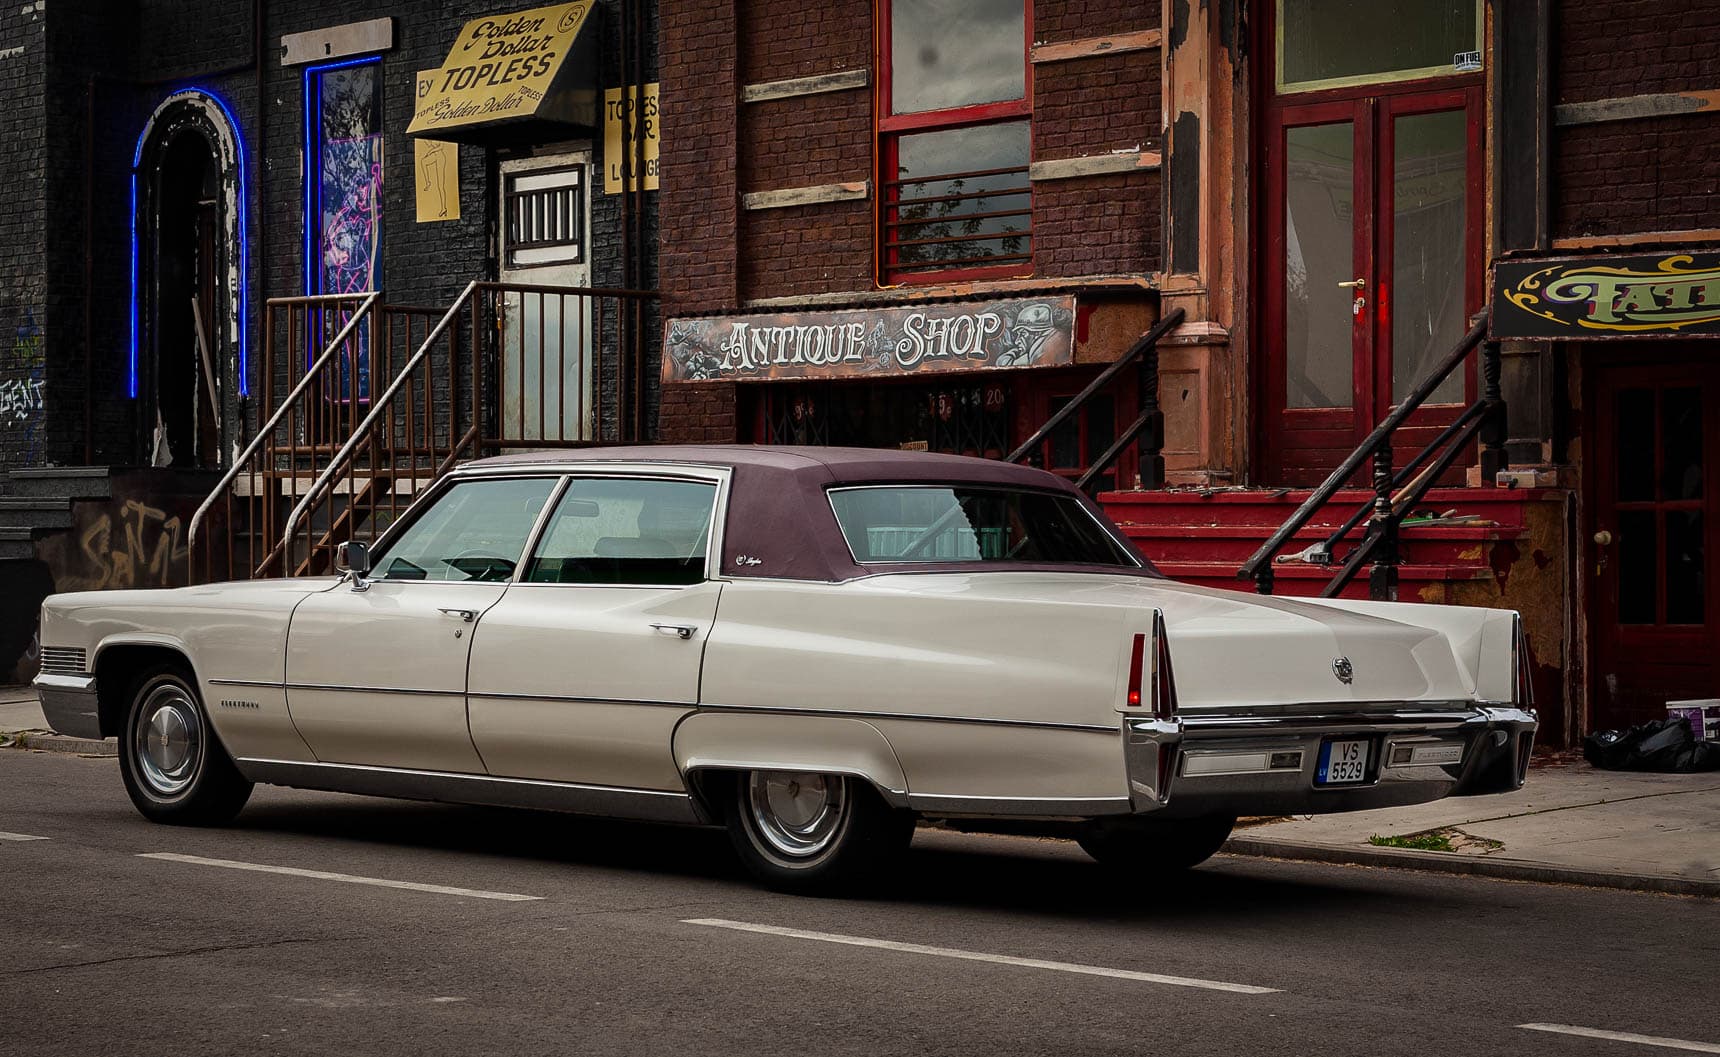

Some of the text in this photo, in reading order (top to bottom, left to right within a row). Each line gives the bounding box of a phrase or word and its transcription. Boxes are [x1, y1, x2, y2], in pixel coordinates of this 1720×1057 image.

[464, 16, 545, 51] Golden
[479, 34, 554, 60] Dollar
[440, 52, 556, 93] TOPLESS
[520, 85, 545, 101] TOPLESS
[416, 97, 450, 119] TOPLESS
[427, 93, 523, 125] Golden Dollar
[719, 313, 1001, 370] ANTIQUE SHOP
[1343, 743, 1360, 761] VS
[1318, 768, 1328, 777] LV
[1331, 762, 1363, 781] 5529
